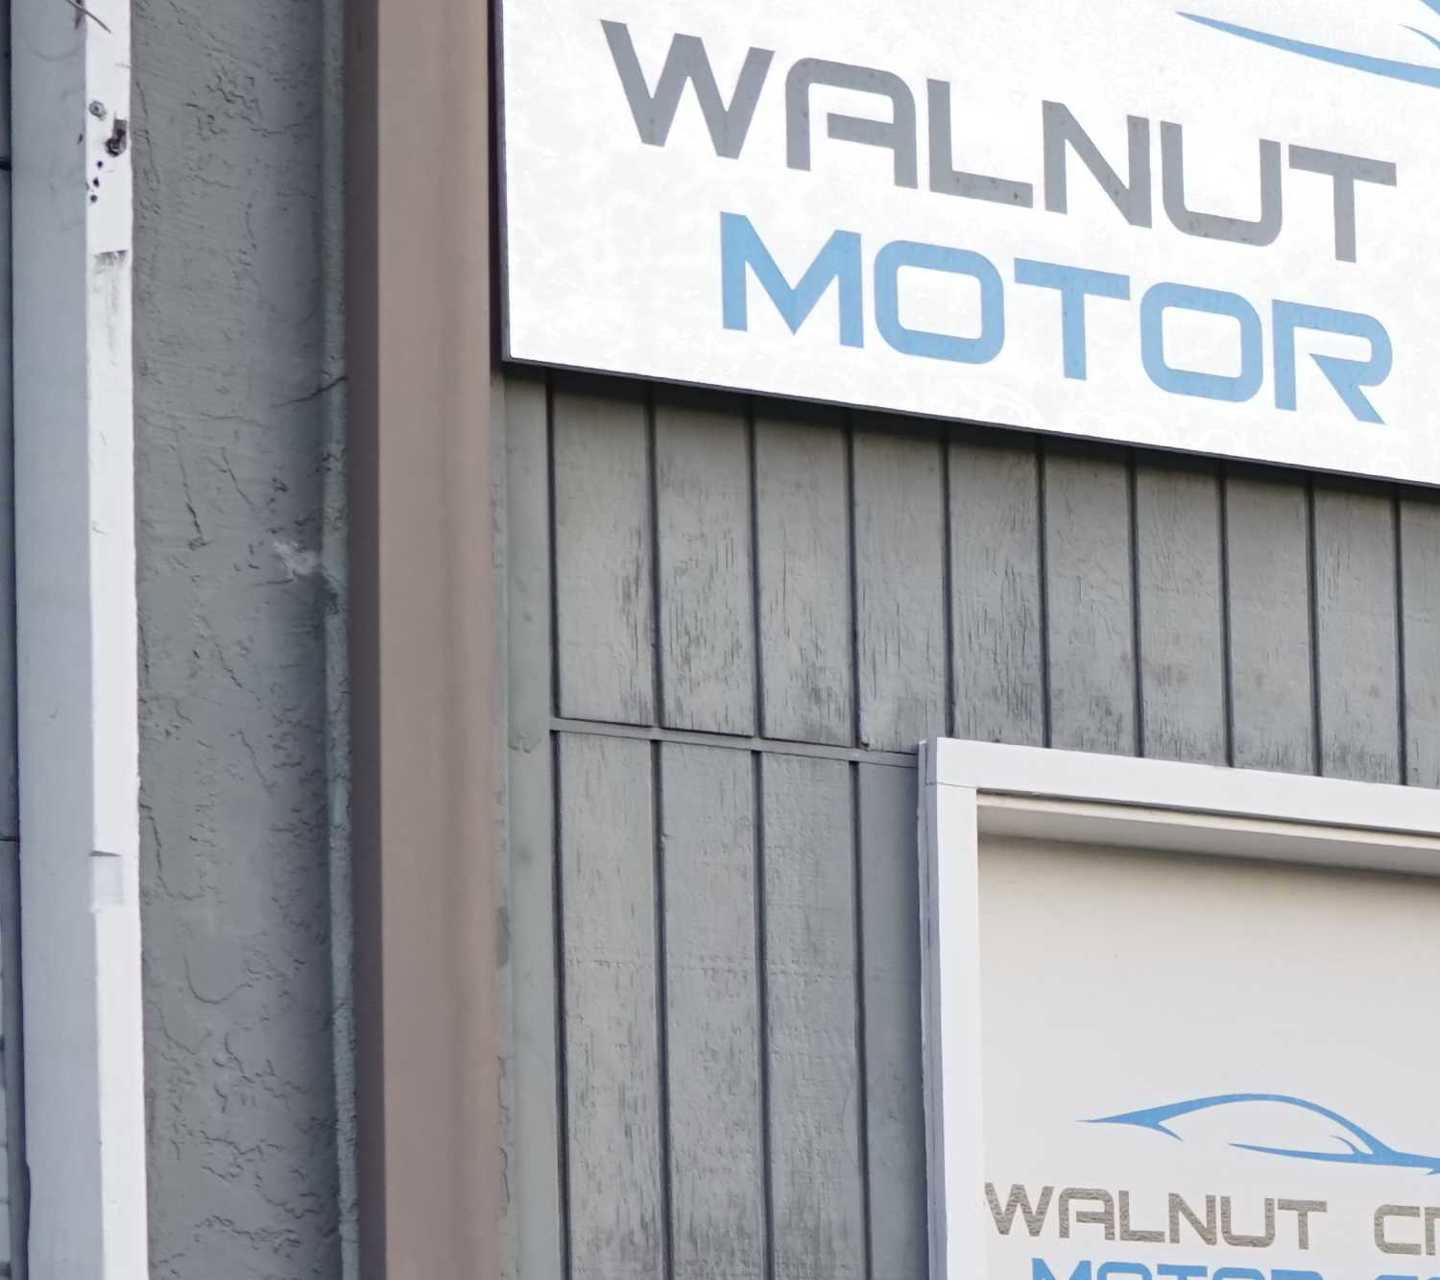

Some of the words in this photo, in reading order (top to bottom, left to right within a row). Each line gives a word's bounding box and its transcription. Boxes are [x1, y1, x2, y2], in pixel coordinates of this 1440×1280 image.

[600, 19, 1396, 263] WALNUT
[718, 213, 1394, 424] MOTOR
[985, 1181, 1326, 1249] WALNUT
